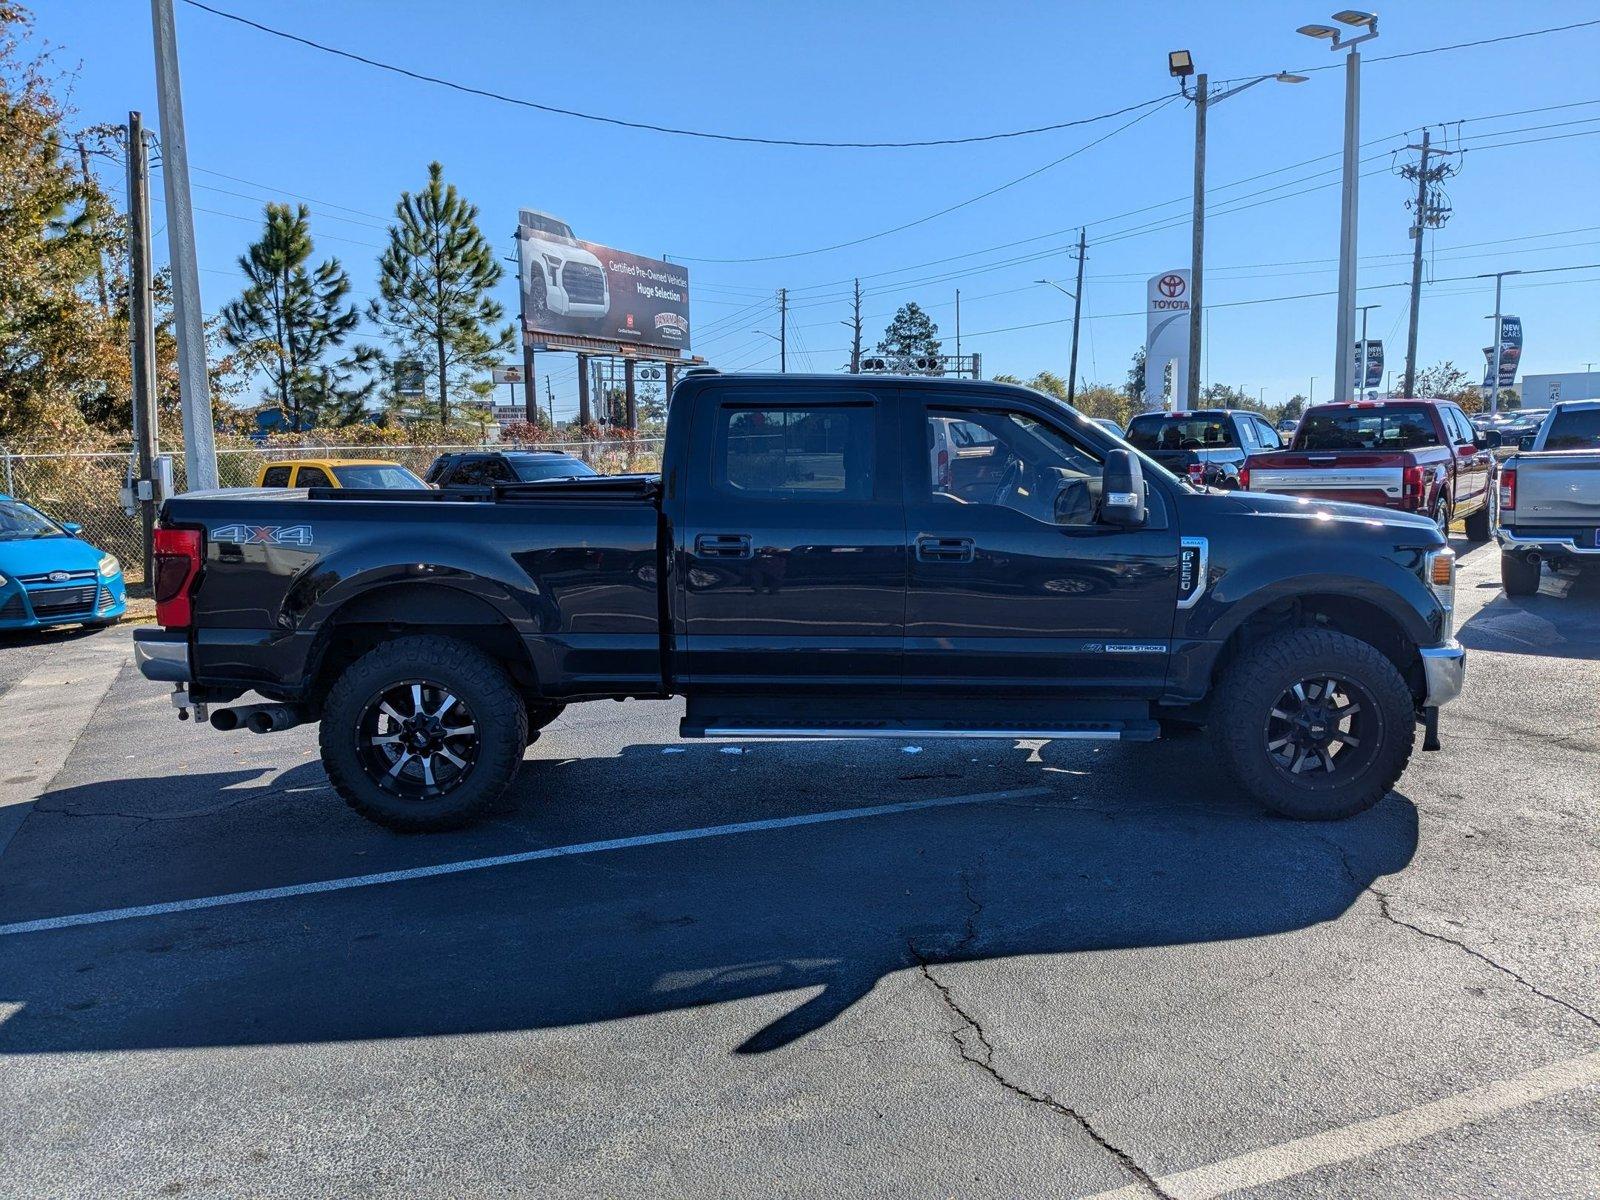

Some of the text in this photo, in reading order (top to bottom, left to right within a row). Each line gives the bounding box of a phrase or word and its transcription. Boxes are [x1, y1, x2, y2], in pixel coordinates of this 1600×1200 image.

[609, 260, 688, 288] Certified Pre-Owned Vehicles
[636, 282, 681, 302] Huge Selection
[1152, 300, 1190, 309] TOYOTA
[663, 327, 681, 336] TOYOTA
[1550, 392, 1560, 401] 45
